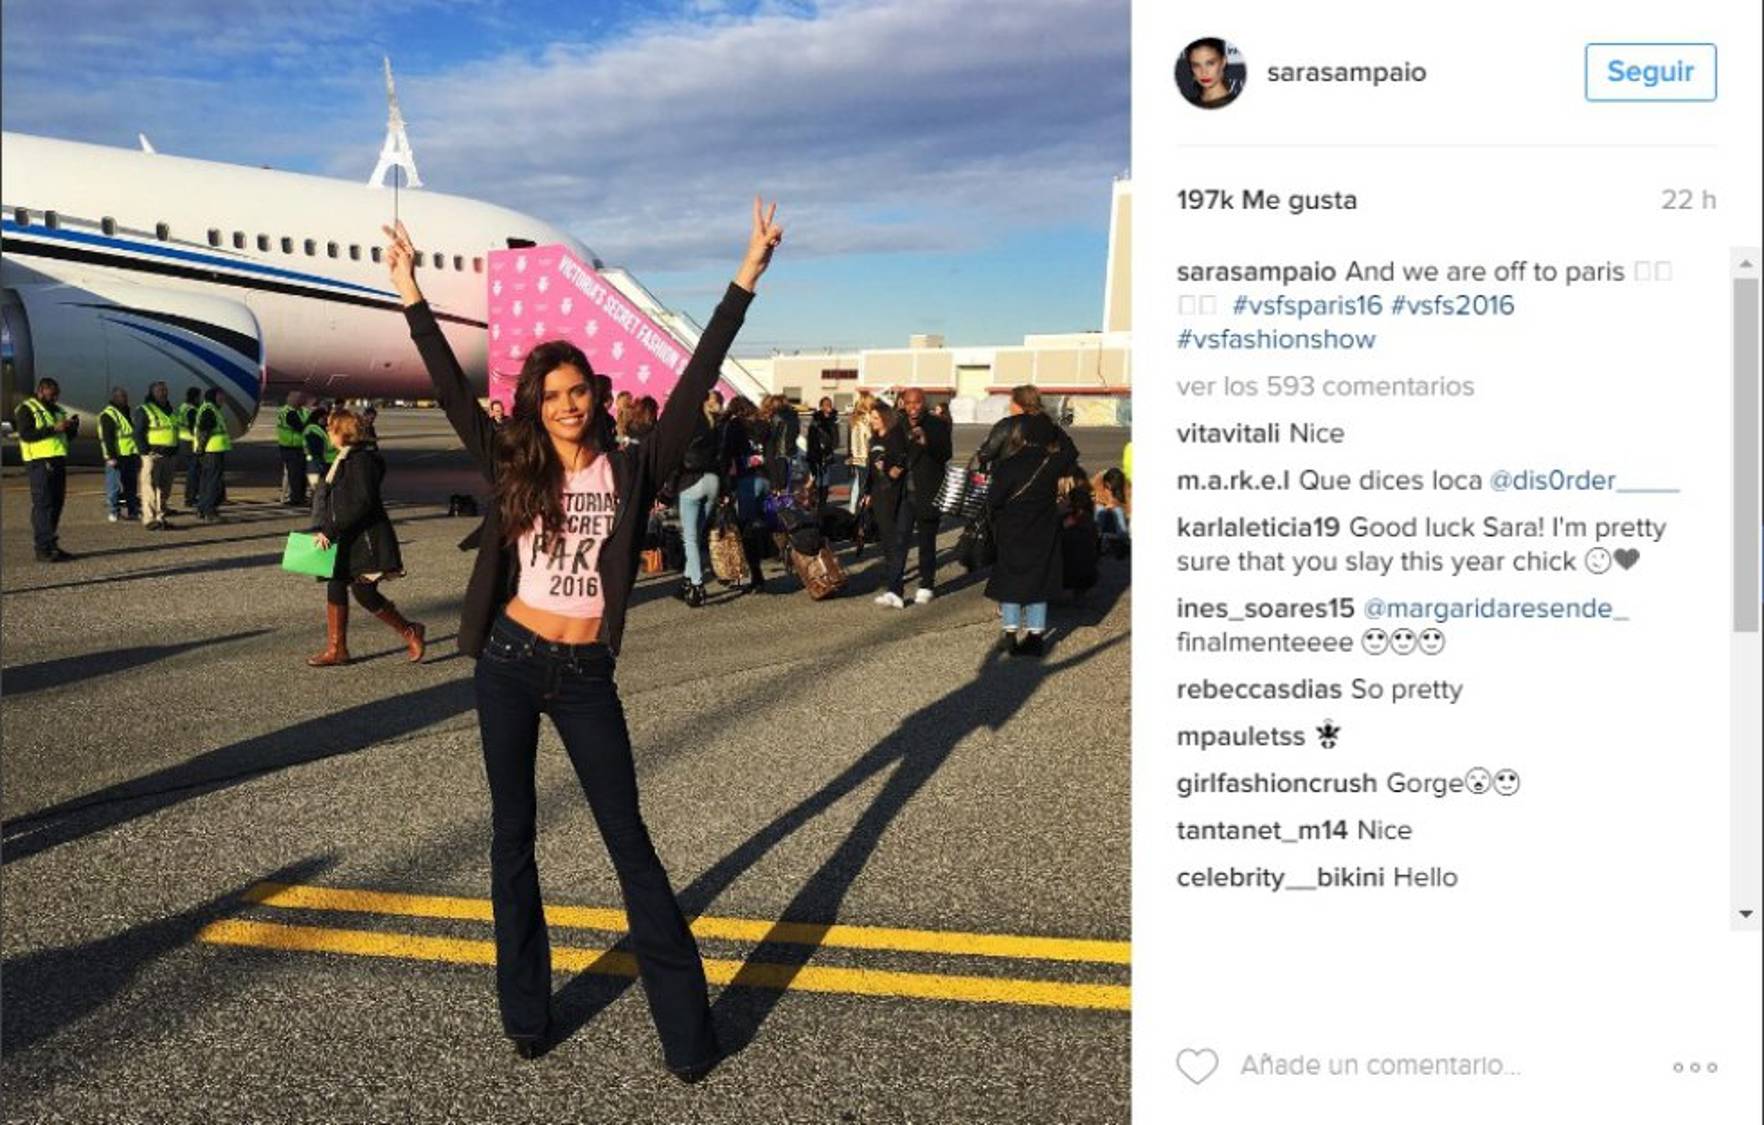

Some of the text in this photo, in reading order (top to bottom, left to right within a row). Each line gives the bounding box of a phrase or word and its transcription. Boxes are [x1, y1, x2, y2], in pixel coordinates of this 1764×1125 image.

[603, 295, 640, 335] SECRET
[635, 323, 679, 369] FASHION
[550, 576, 598, 597] 2016
